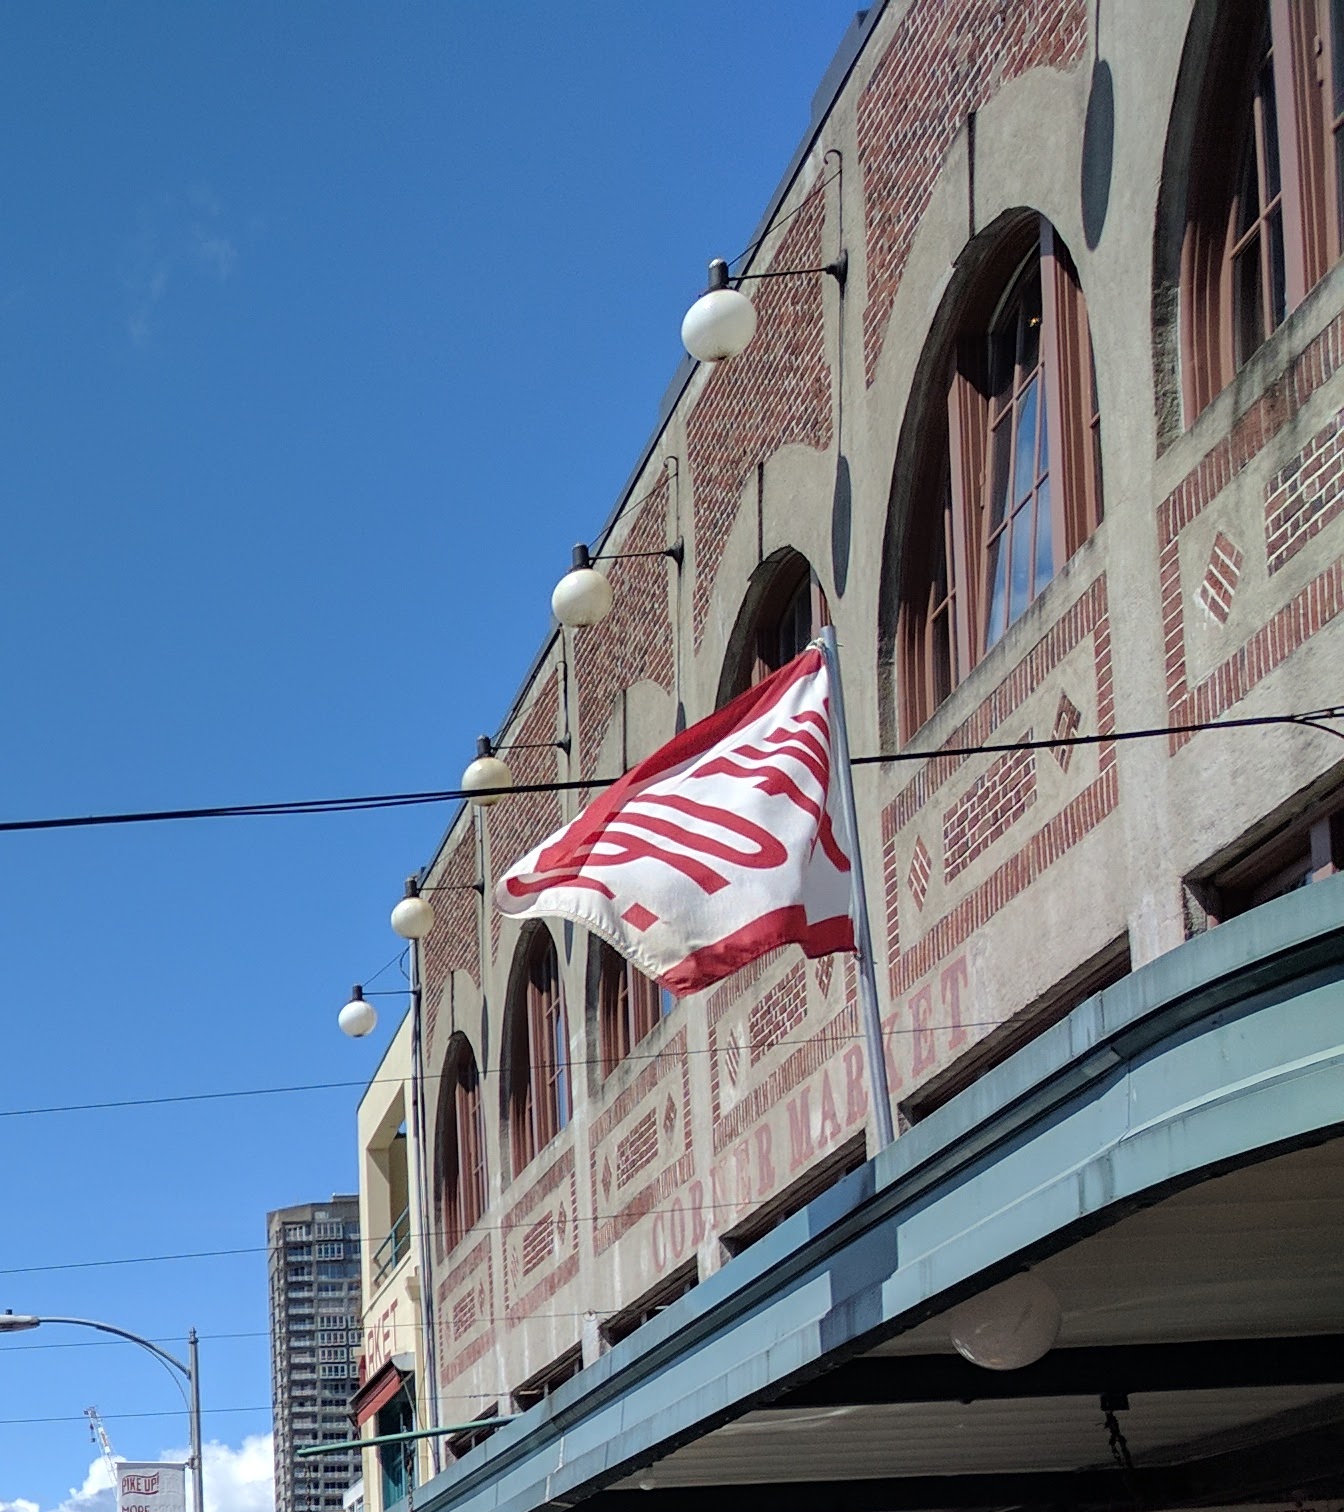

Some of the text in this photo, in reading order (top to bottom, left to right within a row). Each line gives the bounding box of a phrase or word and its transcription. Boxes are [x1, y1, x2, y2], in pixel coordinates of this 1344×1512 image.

[651, 1123, 776, 1274] CORNER
[122, 1475, 159, 1493] PIKE UP!
